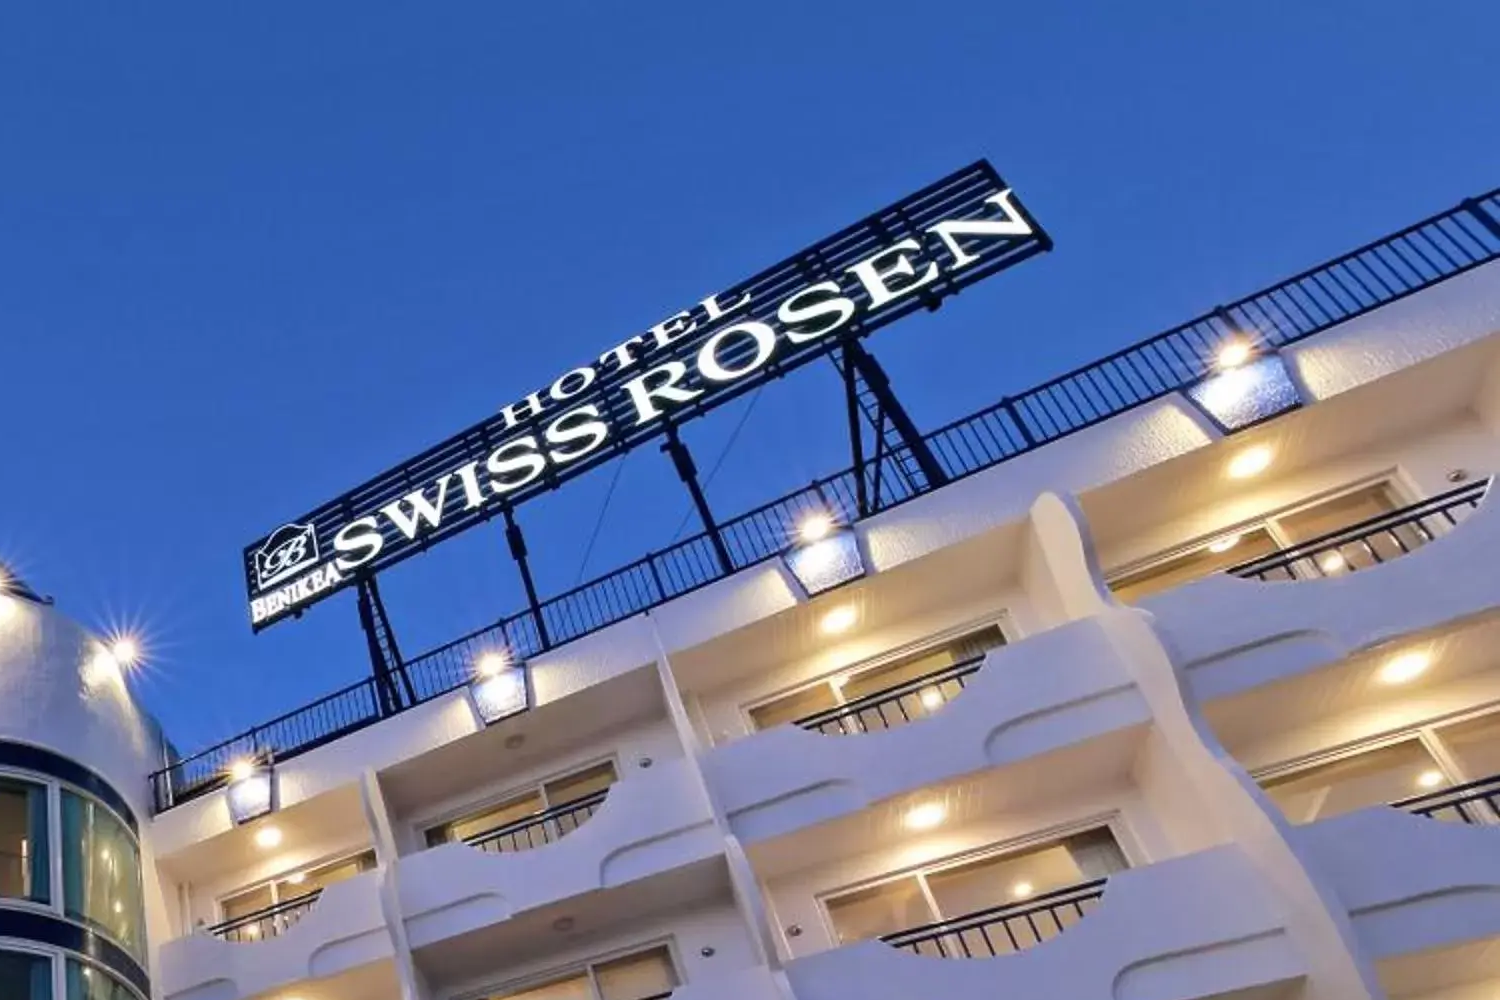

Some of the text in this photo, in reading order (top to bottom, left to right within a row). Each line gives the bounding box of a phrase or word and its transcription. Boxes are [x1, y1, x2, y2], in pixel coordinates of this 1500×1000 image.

[333, 189, 1034, 571] SWISS ROSEN
[502, 292, 751, 428] HOTEL
[250, 561, 343, 624] BENIKEA
